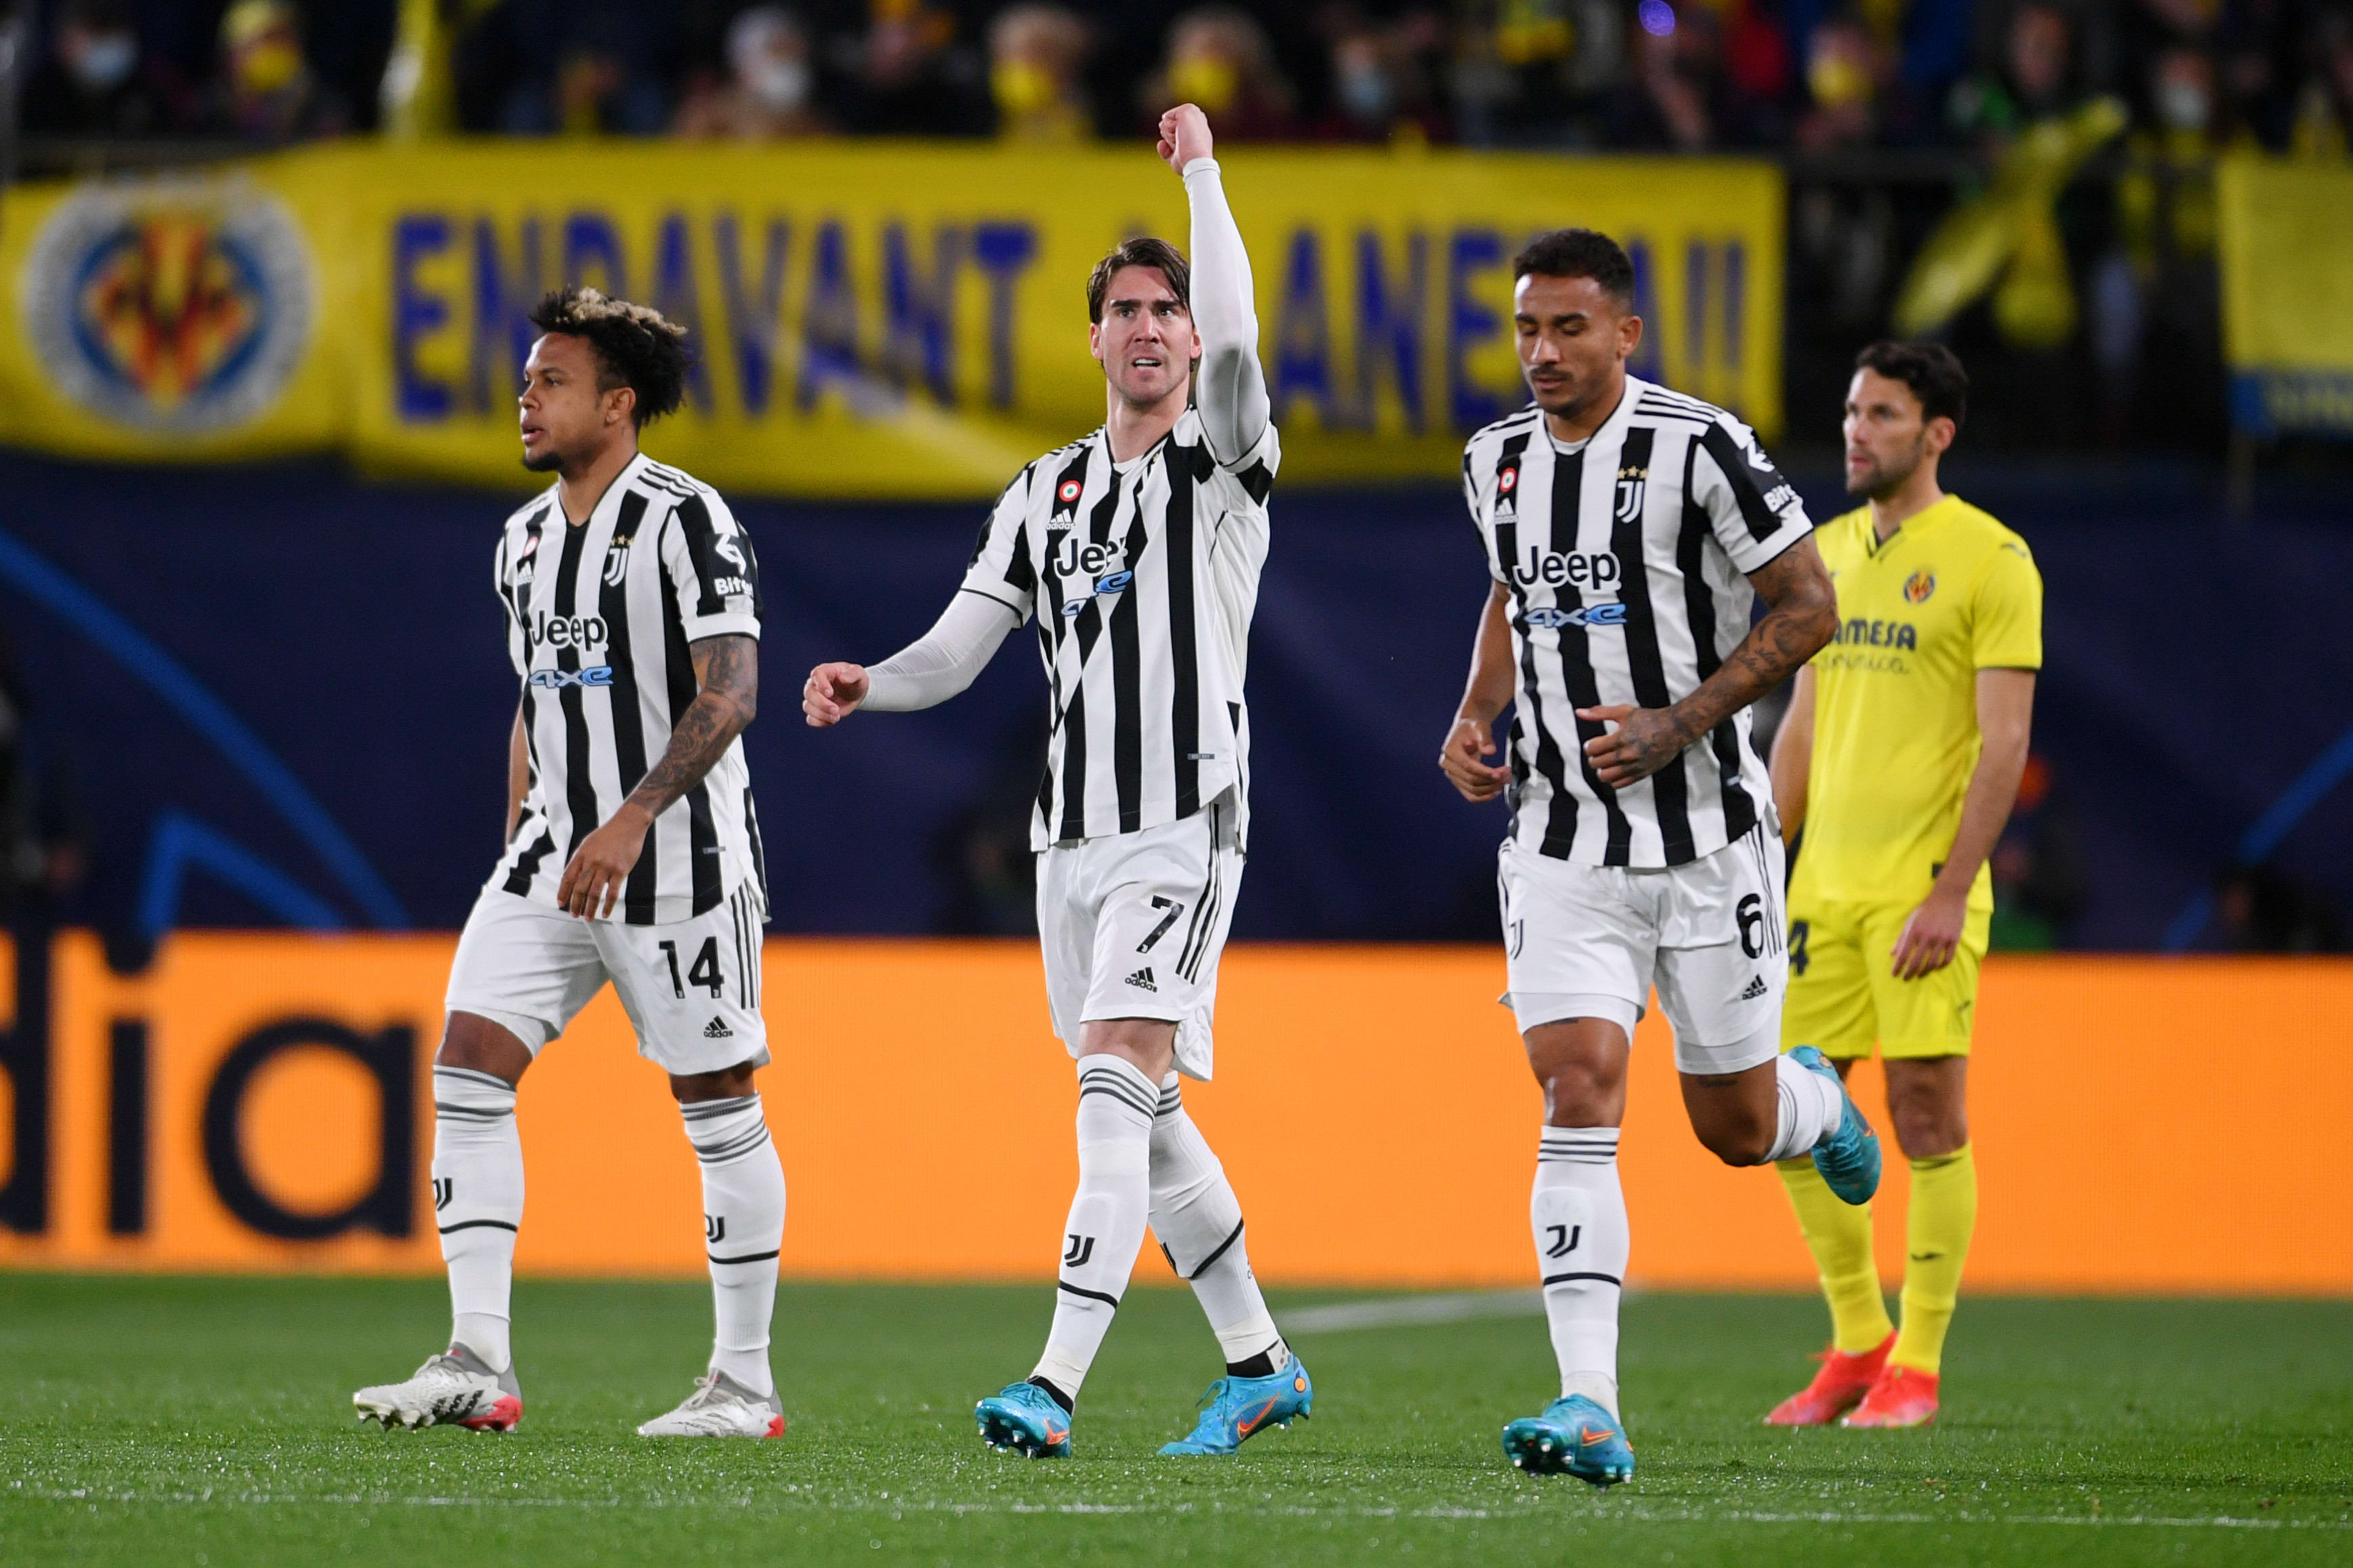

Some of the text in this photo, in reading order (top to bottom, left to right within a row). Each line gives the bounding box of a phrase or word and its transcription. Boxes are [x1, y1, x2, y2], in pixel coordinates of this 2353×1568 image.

[1516, 545, 1618, 590] Jeep
[531, 610, 607, 652] Jeep
[1525, 603, 1627, 629] 4xe
[529, 665, 614, 689] 4xe
[1136, 894, 1185, 954] 7
[1736, 893, 1764, 960] 6
[659, 936, 725, 999] 14
[1125, 977, 1158, 993] adidas
[703, 1029, 733, 1039] adidas
